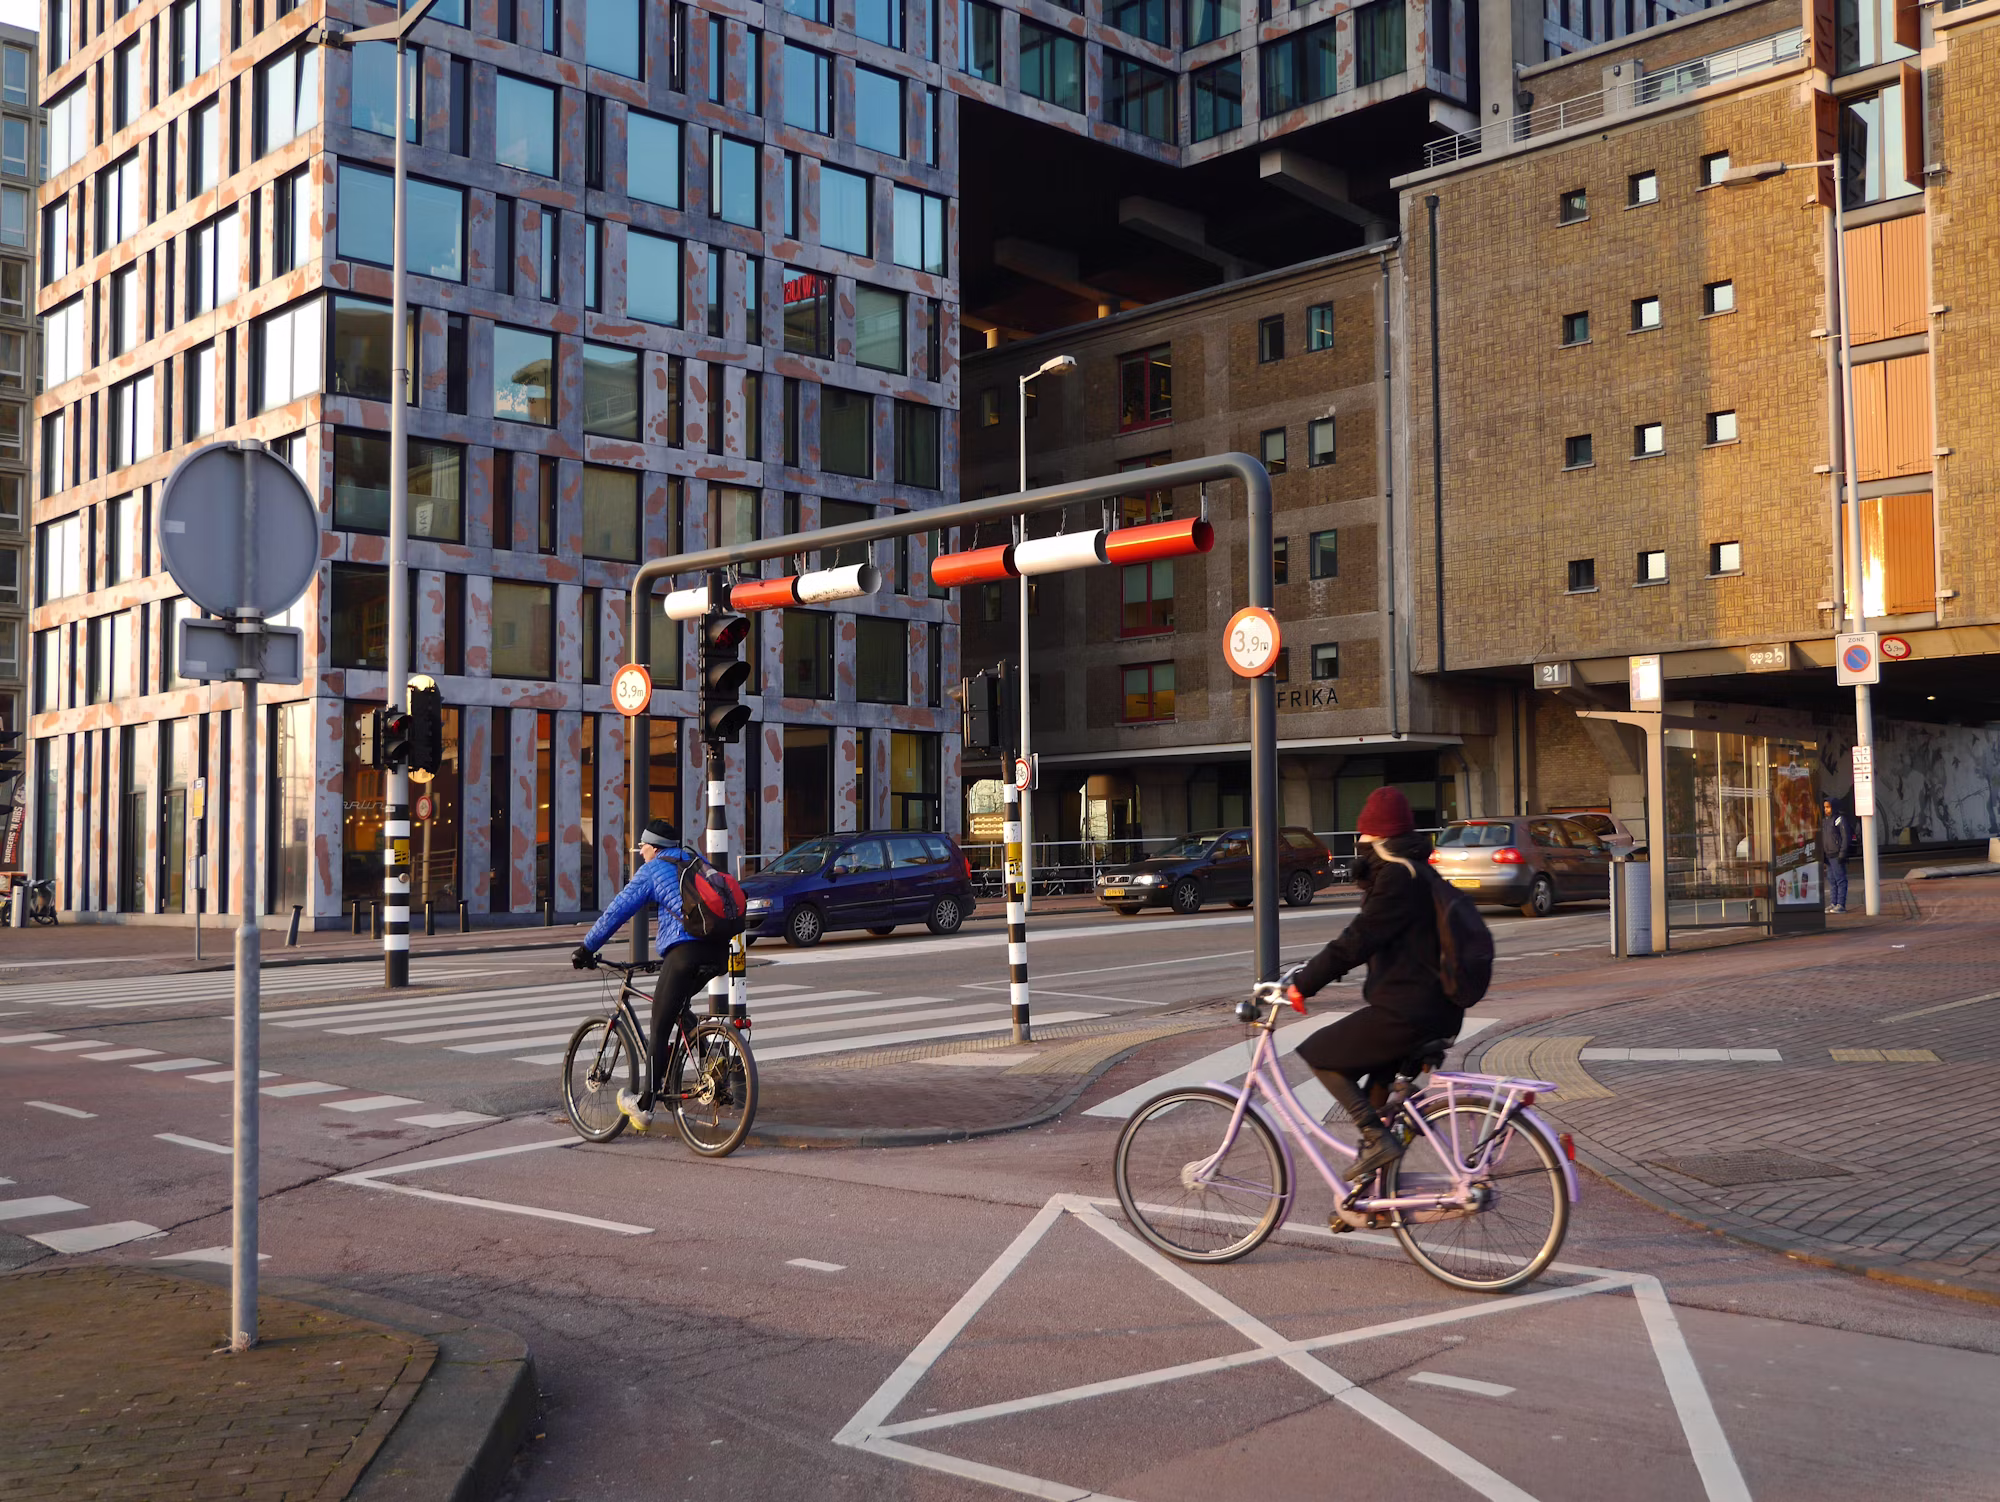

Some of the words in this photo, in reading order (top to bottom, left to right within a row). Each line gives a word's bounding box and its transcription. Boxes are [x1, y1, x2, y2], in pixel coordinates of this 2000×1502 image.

[1234, 631, 1268, 654] 3,9m
[1543, 664, 1559, 681] 21
[619, 681, 643, 699] 3,9m
[1277, 687, 1339, 708] FRIKA
[4, 831, 16, 863] BURGERS
[11, 806, 23, 824] RIBS
